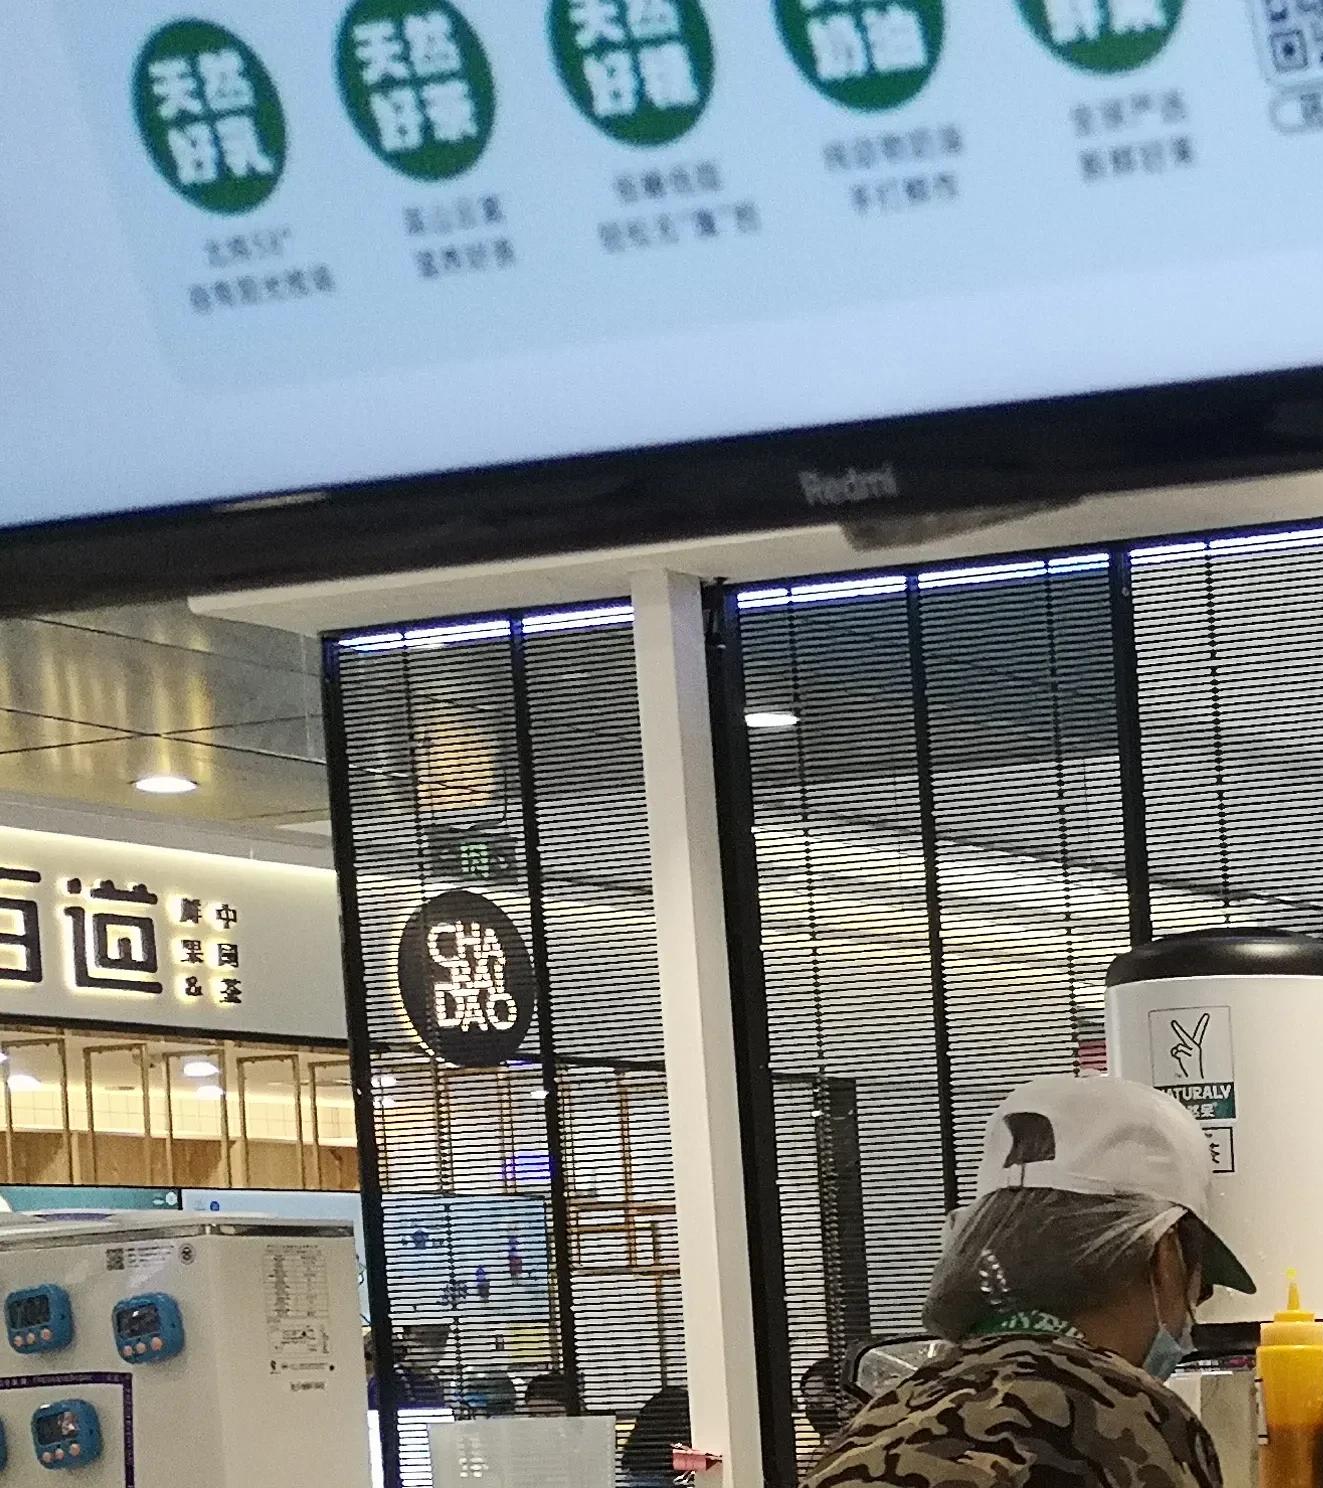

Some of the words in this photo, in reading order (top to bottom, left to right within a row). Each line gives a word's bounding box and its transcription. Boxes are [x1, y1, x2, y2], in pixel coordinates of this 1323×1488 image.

[352, 8, 463, 84] 天然
[149, 49, 255, 120] 天然
[369, 78, 478, 152] 好茶
[167, 114, 274, 186] 好乳
[428, 920, 506, 968] CHA
[434, 982, 517, 1032] DAO
[1162, 1084, 1231, 1100] ATURALV
